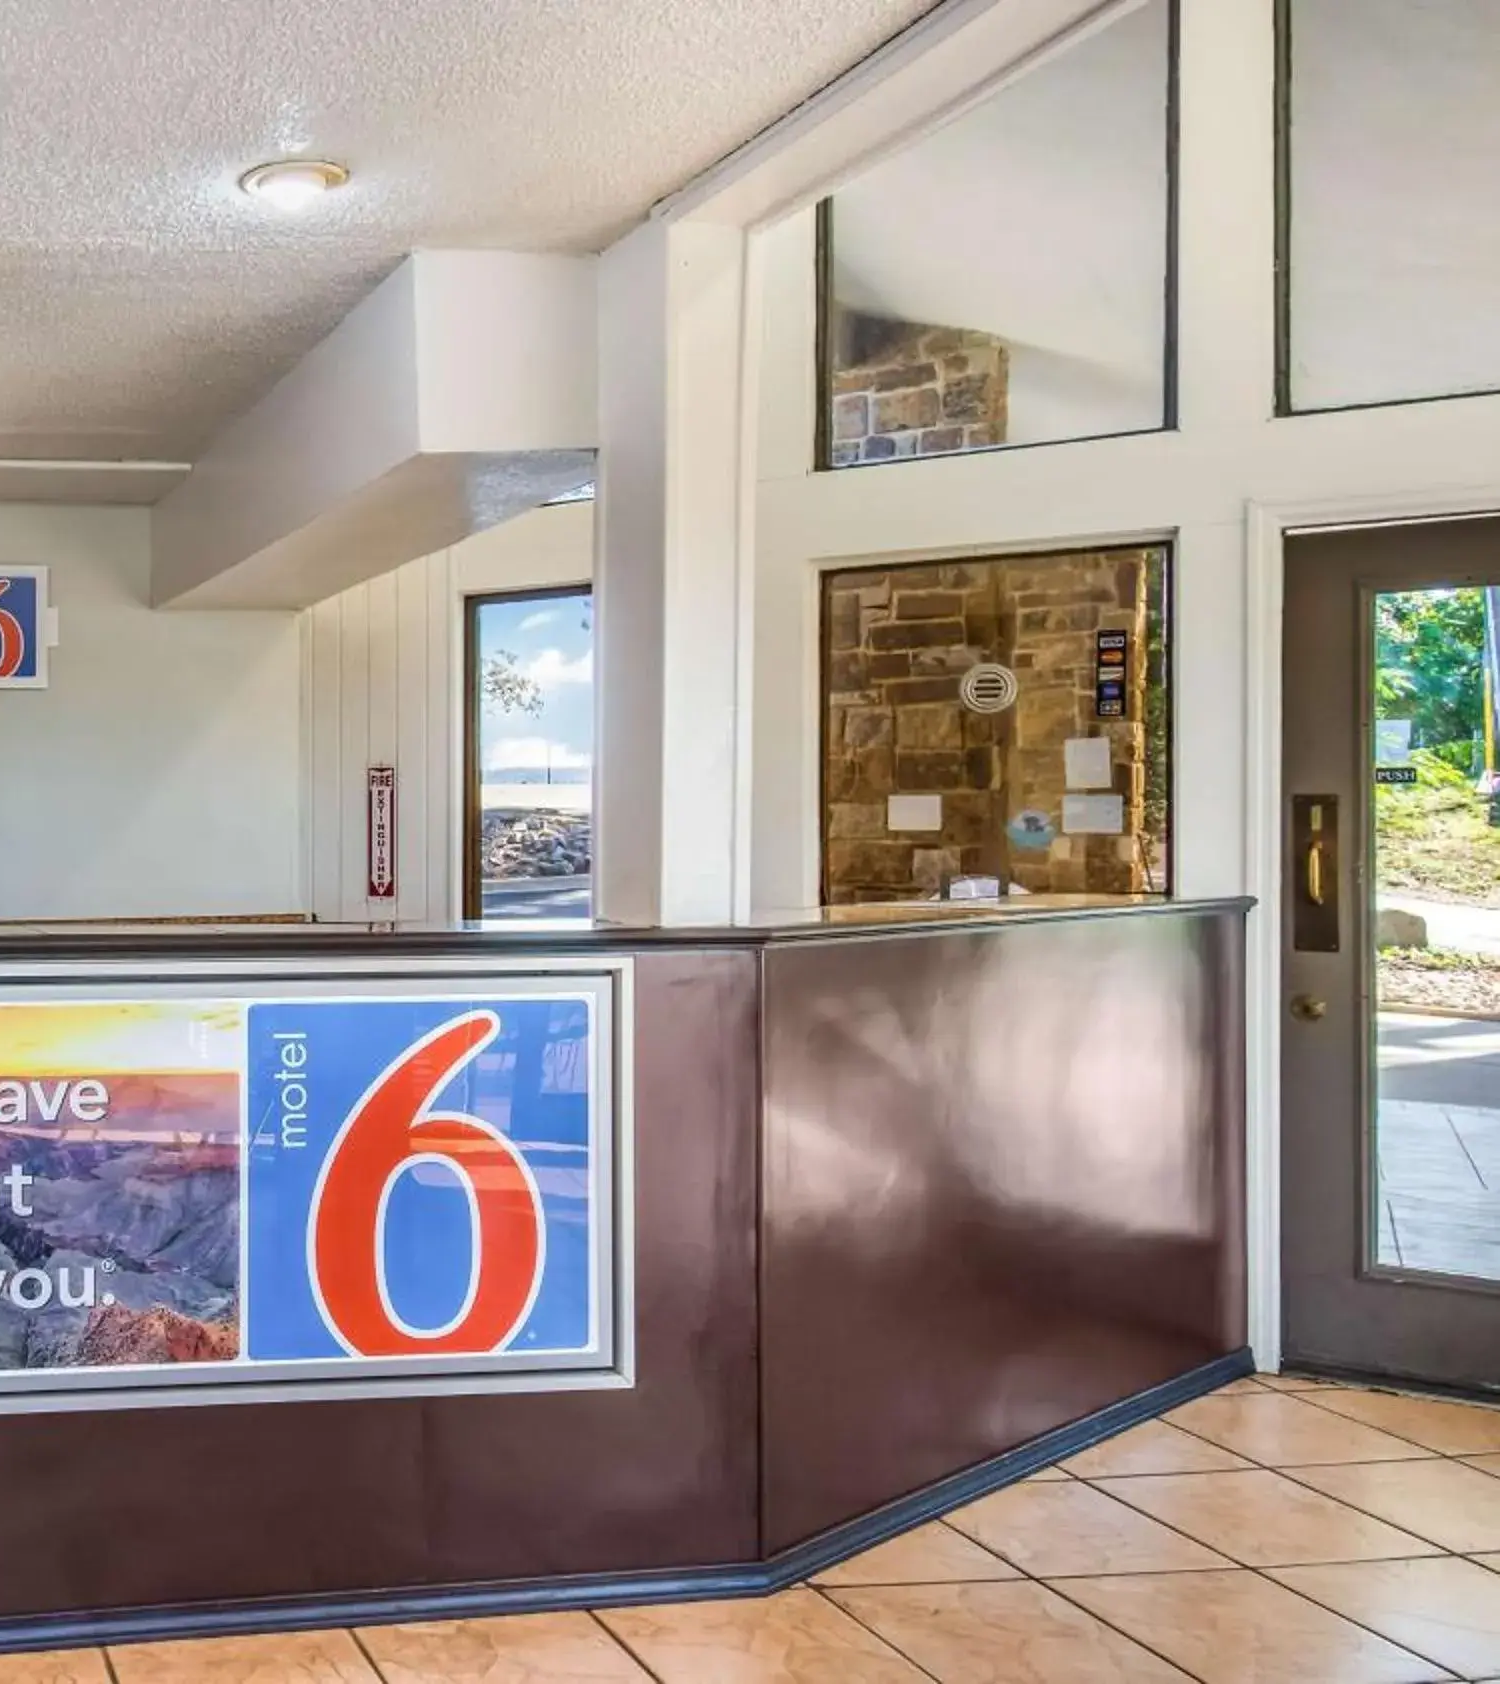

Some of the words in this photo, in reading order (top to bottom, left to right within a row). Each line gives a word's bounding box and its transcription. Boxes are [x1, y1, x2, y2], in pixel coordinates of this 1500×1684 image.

[371, 775, 392, 787] FIRE
[1377, 771, 1415, 781] PUSH
[272, 1032, 307, 1149] motel
[306, 1008, 547, 1358] 6
